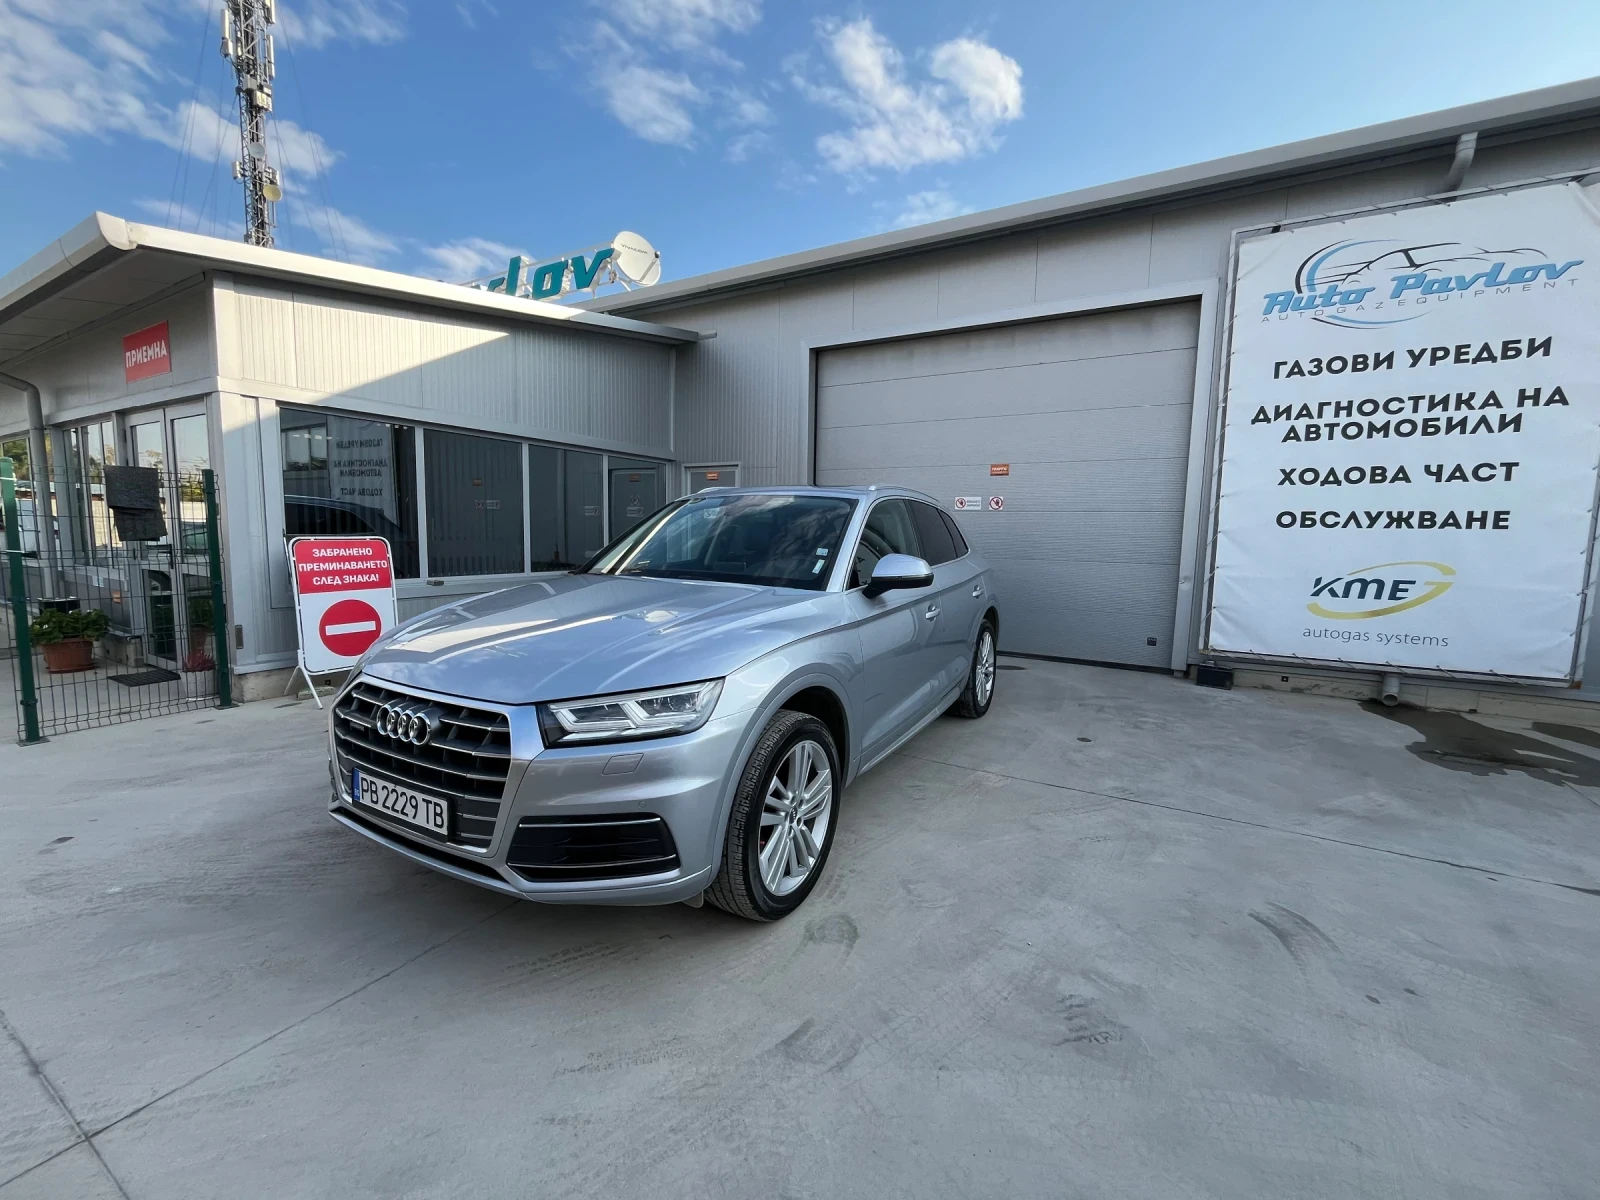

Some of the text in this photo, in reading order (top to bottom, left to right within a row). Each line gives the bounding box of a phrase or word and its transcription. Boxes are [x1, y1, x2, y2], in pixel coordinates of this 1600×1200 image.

[1262, 284, 1376, 316] Auto
[125, 339, 168, 368] ПРИЕМНА
[1273, 336, 1553, 380] ГАЗОВИ УРЕДБИ
[1250, 385, 1570, 425] ДИАГНОСТИКА НА
[1281, 412, 1523, 443] АВТОМОБИЛИ
[1277, 461, 1520, 487] ХОДОВА ЧАСТ
[1275, 510, 1511, 530] ОБСЛУЖВАНЕ
[312, 547, 373, 557] ЗАБРАНЕНО
[298, 560, 388, 572] ПРЕМИНАВАНЕТО
[312, 573, 379, 586] СЛЕД ЗНАКА!
[1310, 576, 1417, 601] KME
[1302, 627, 1449, 647] autogas systems
